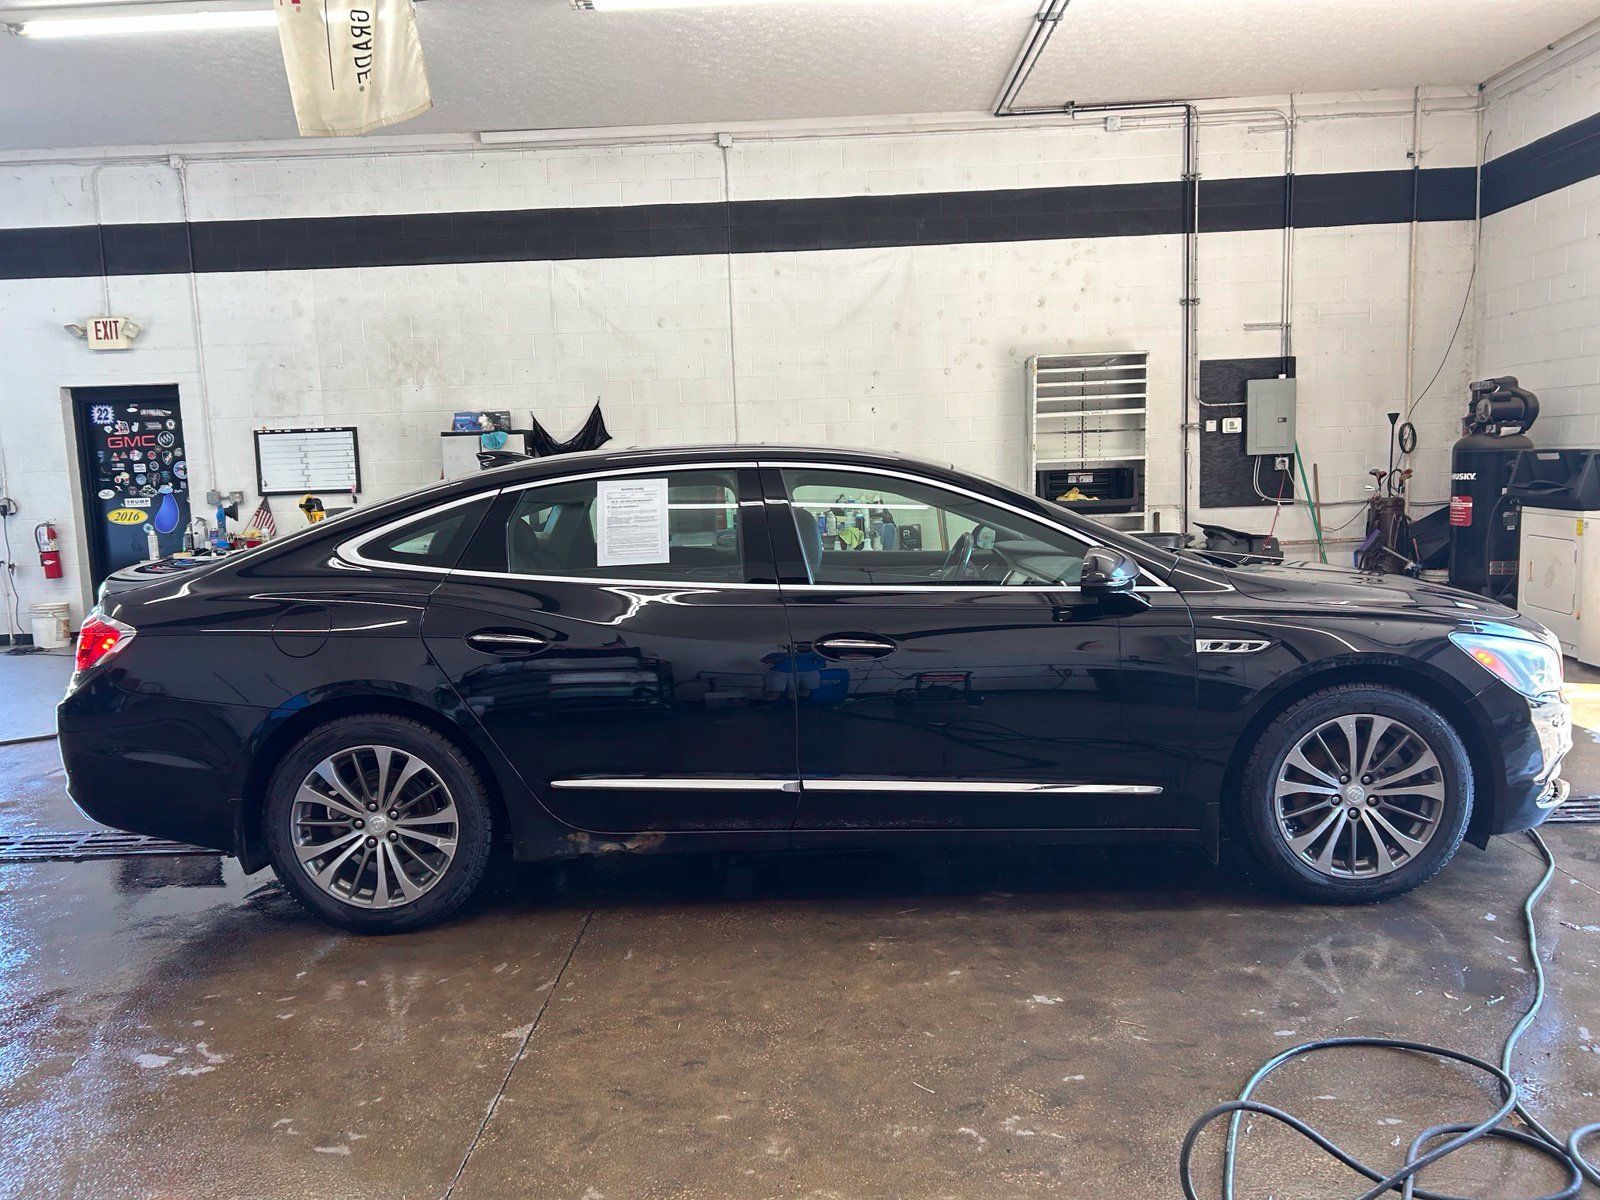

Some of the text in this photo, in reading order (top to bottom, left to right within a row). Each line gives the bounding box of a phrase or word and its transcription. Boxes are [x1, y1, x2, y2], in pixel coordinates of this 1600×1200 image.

[94, 320, 119, 340] EXIT
[96, 408, 110, 421] 22
[107, 435, 156, 448] GMC
[114, 512, 141, 521] 2016
